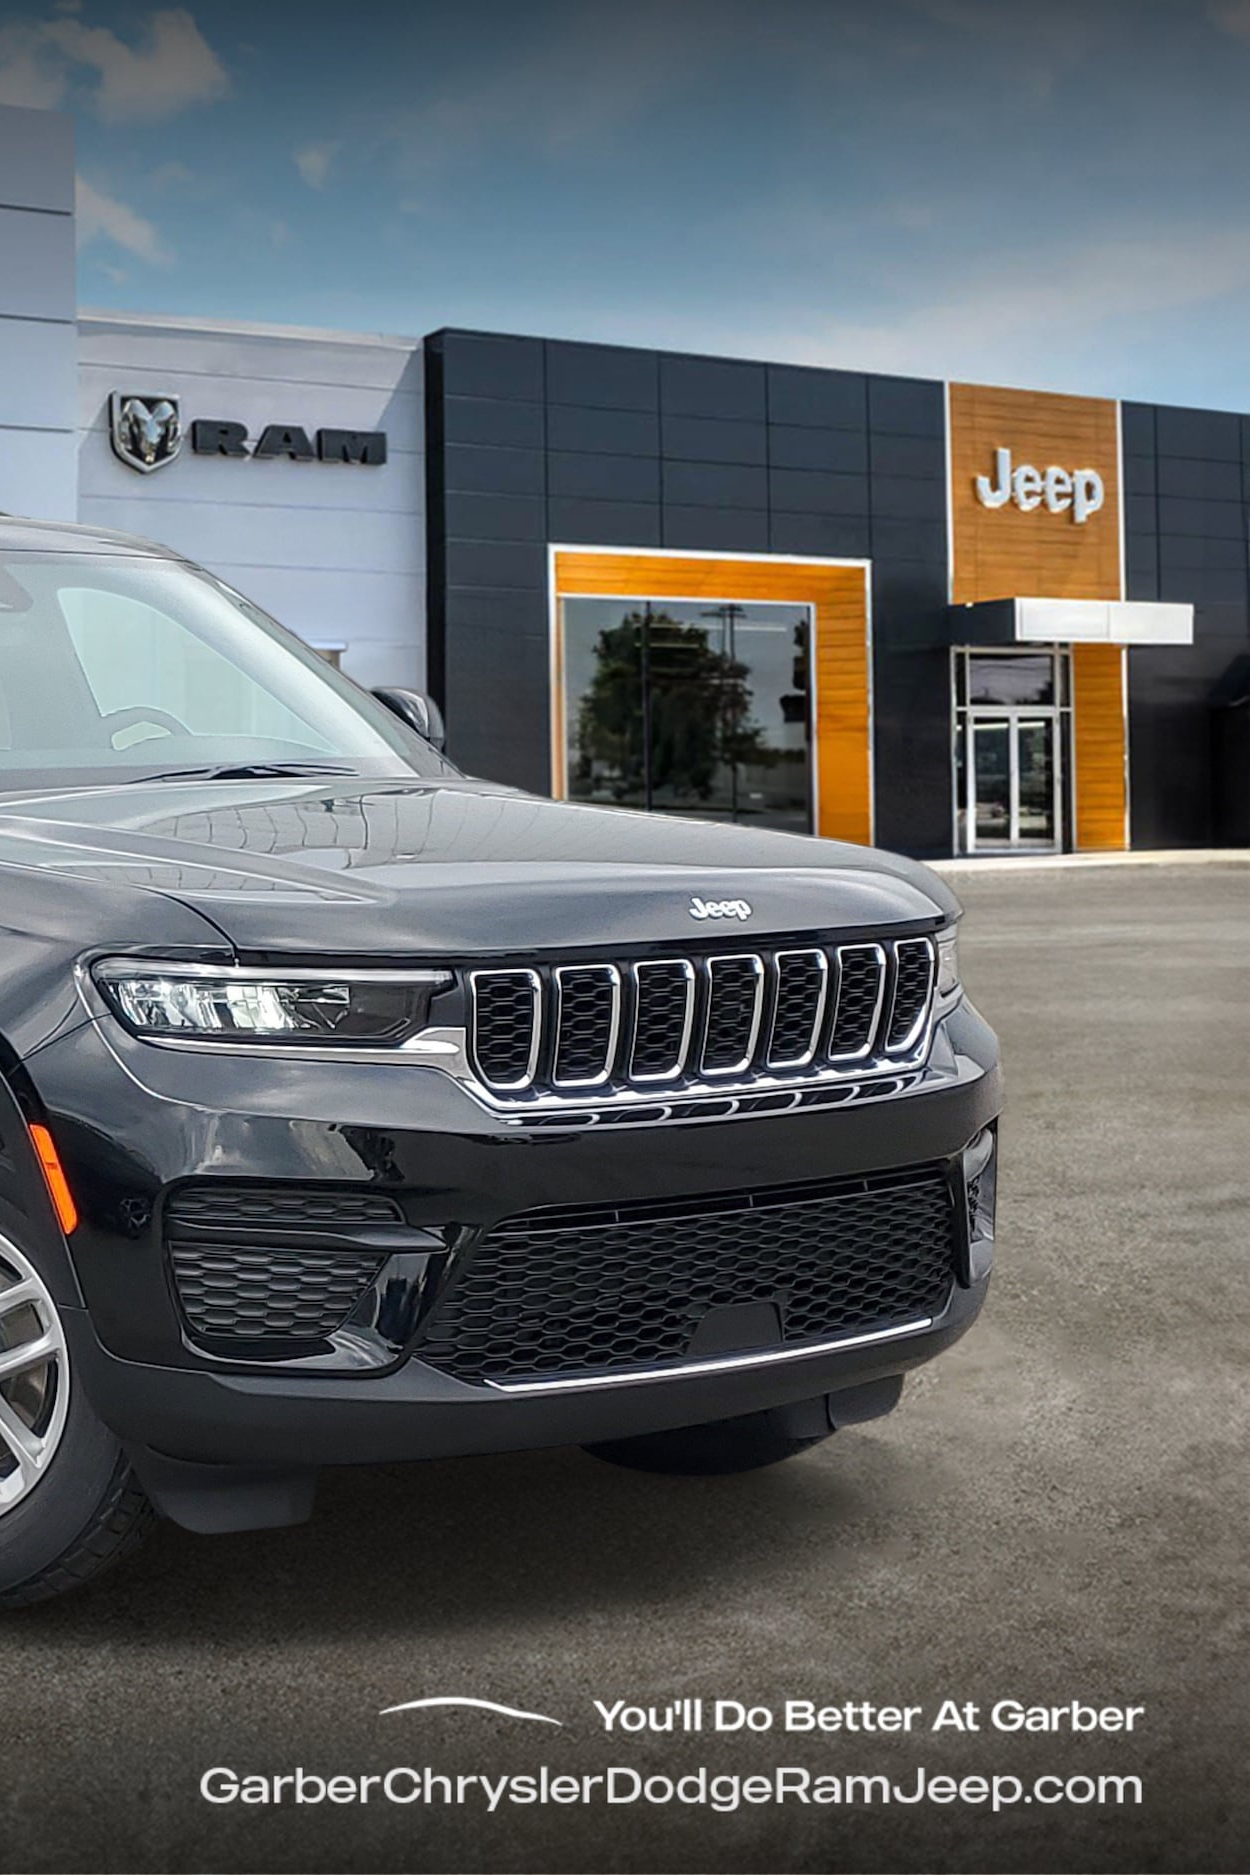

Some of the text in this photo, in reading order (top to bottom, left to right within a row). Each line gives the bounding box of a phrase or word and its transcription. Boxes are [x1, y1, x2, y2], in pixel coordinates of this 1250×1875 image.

[191, 418, 388, 466] RAM
[975, 447, 1105, 524] Jeep
[688, 897, 753, 921] Jeep
